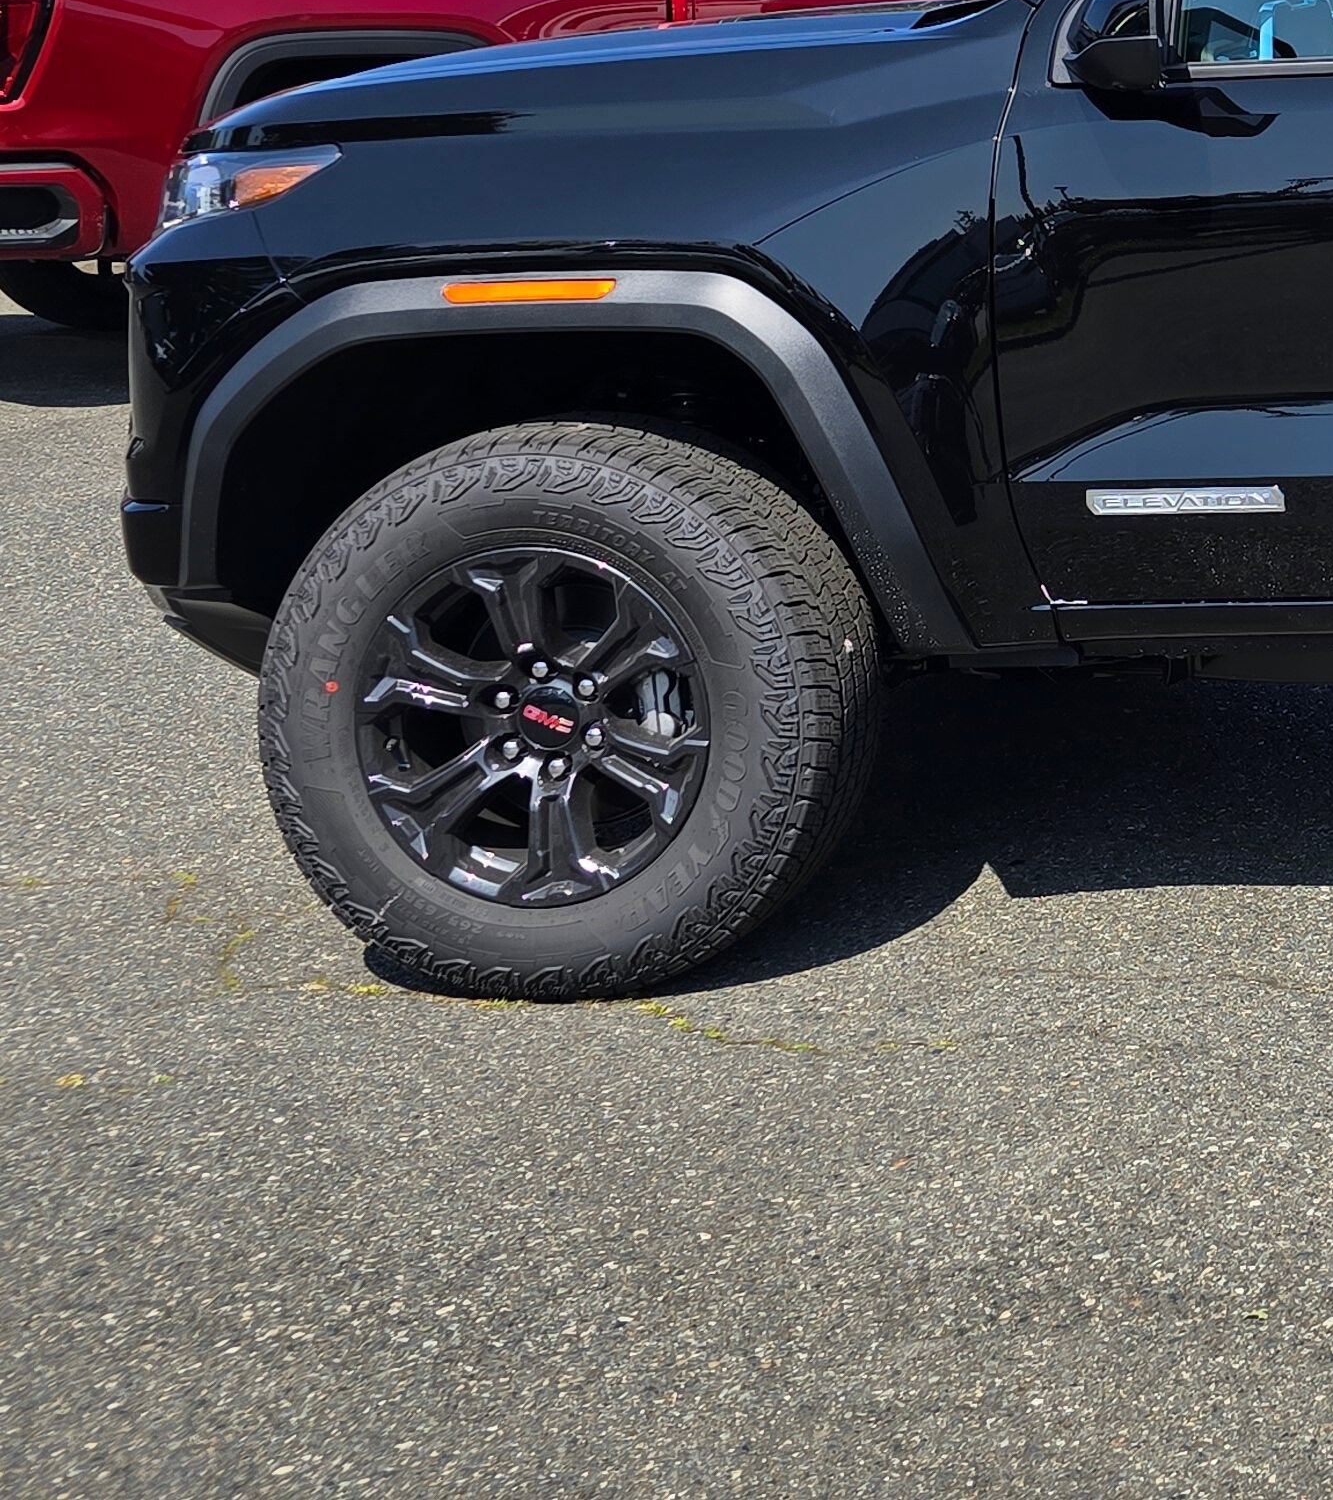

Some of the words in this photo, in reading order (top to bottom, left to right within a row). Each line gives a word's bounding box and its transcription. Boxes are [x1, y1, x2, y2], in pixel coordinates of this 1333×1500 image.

[1100, 491, 1275, 510] ELEVATION
[532, 510, 656, 564] TERRITORY
[660, 571, 688, 592] AT
[300, 529, 432, 764] WRANGLER
[522, 703, 575, 734] GMC
[619, 690, 750, 933] GOODYEAR
